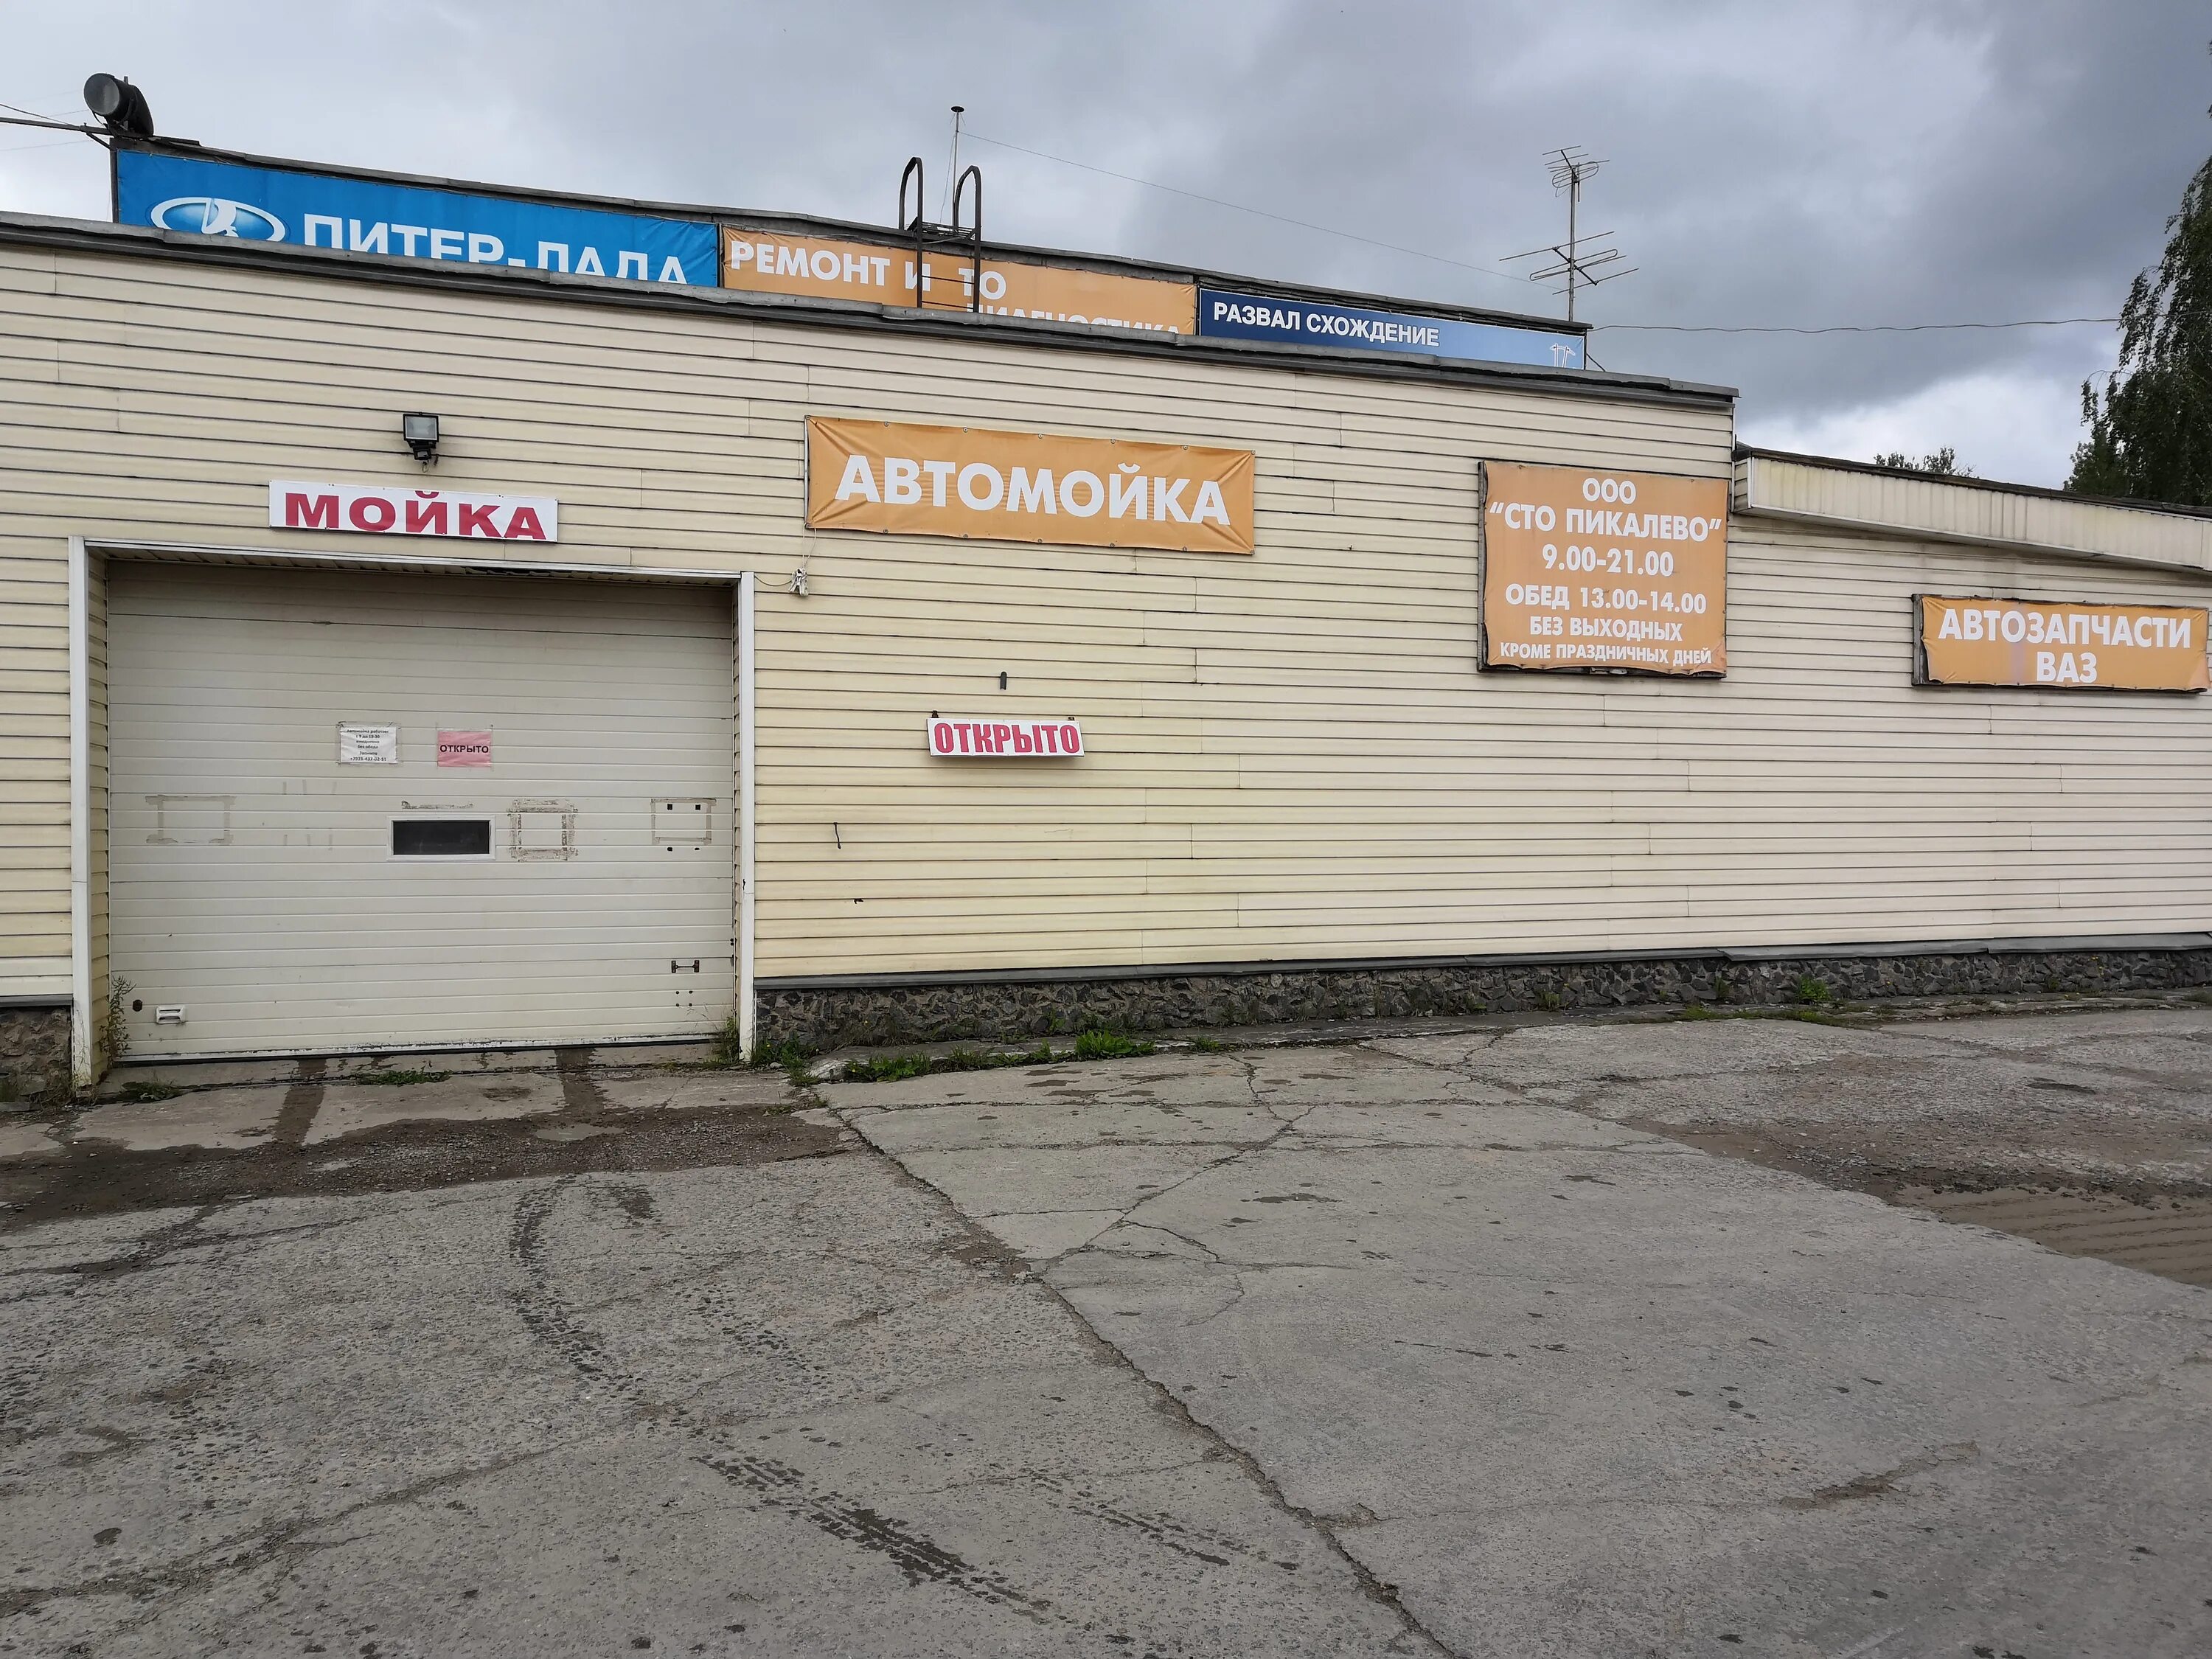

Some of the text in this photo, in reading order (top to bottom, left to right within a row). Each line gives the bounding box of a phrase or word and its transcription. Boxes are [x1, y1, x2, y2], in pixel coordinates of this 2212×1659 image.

[731, 240, 1007, 300] РЕМОНТ И ТО
[1213, 301, 1301, 331] РАЗВАЛ
[1307, 313, 1440, 347] СХОЖДЕНИЕ
[835, 454, 1230, 526] АВТОМОЙКА
[1582, 478, 1636, 504] ООО
[285, 490, 546, 540] МОЙКА
[1542, 543, 1674, 577] 9.00-21.00
[1505, 583, 1707, 614] ОБЕД 13.00-14.00
[1530, 616, 1683, 641] БЕЗ ВЫХОДНЫХ
[1938, 608, 2191, 649] АВТОЗАПЧАСТИ
[1500, 642, 1711, 667] КРОМЕ ПРАЗДНИЧНЫХ ДНЕЙ
[2037, 651, 2097, 684] ВАЗ
[439, 744, 489, 754] ОТКРЫТО
[934, 723, 1079, 754] ОТКРЫТО
